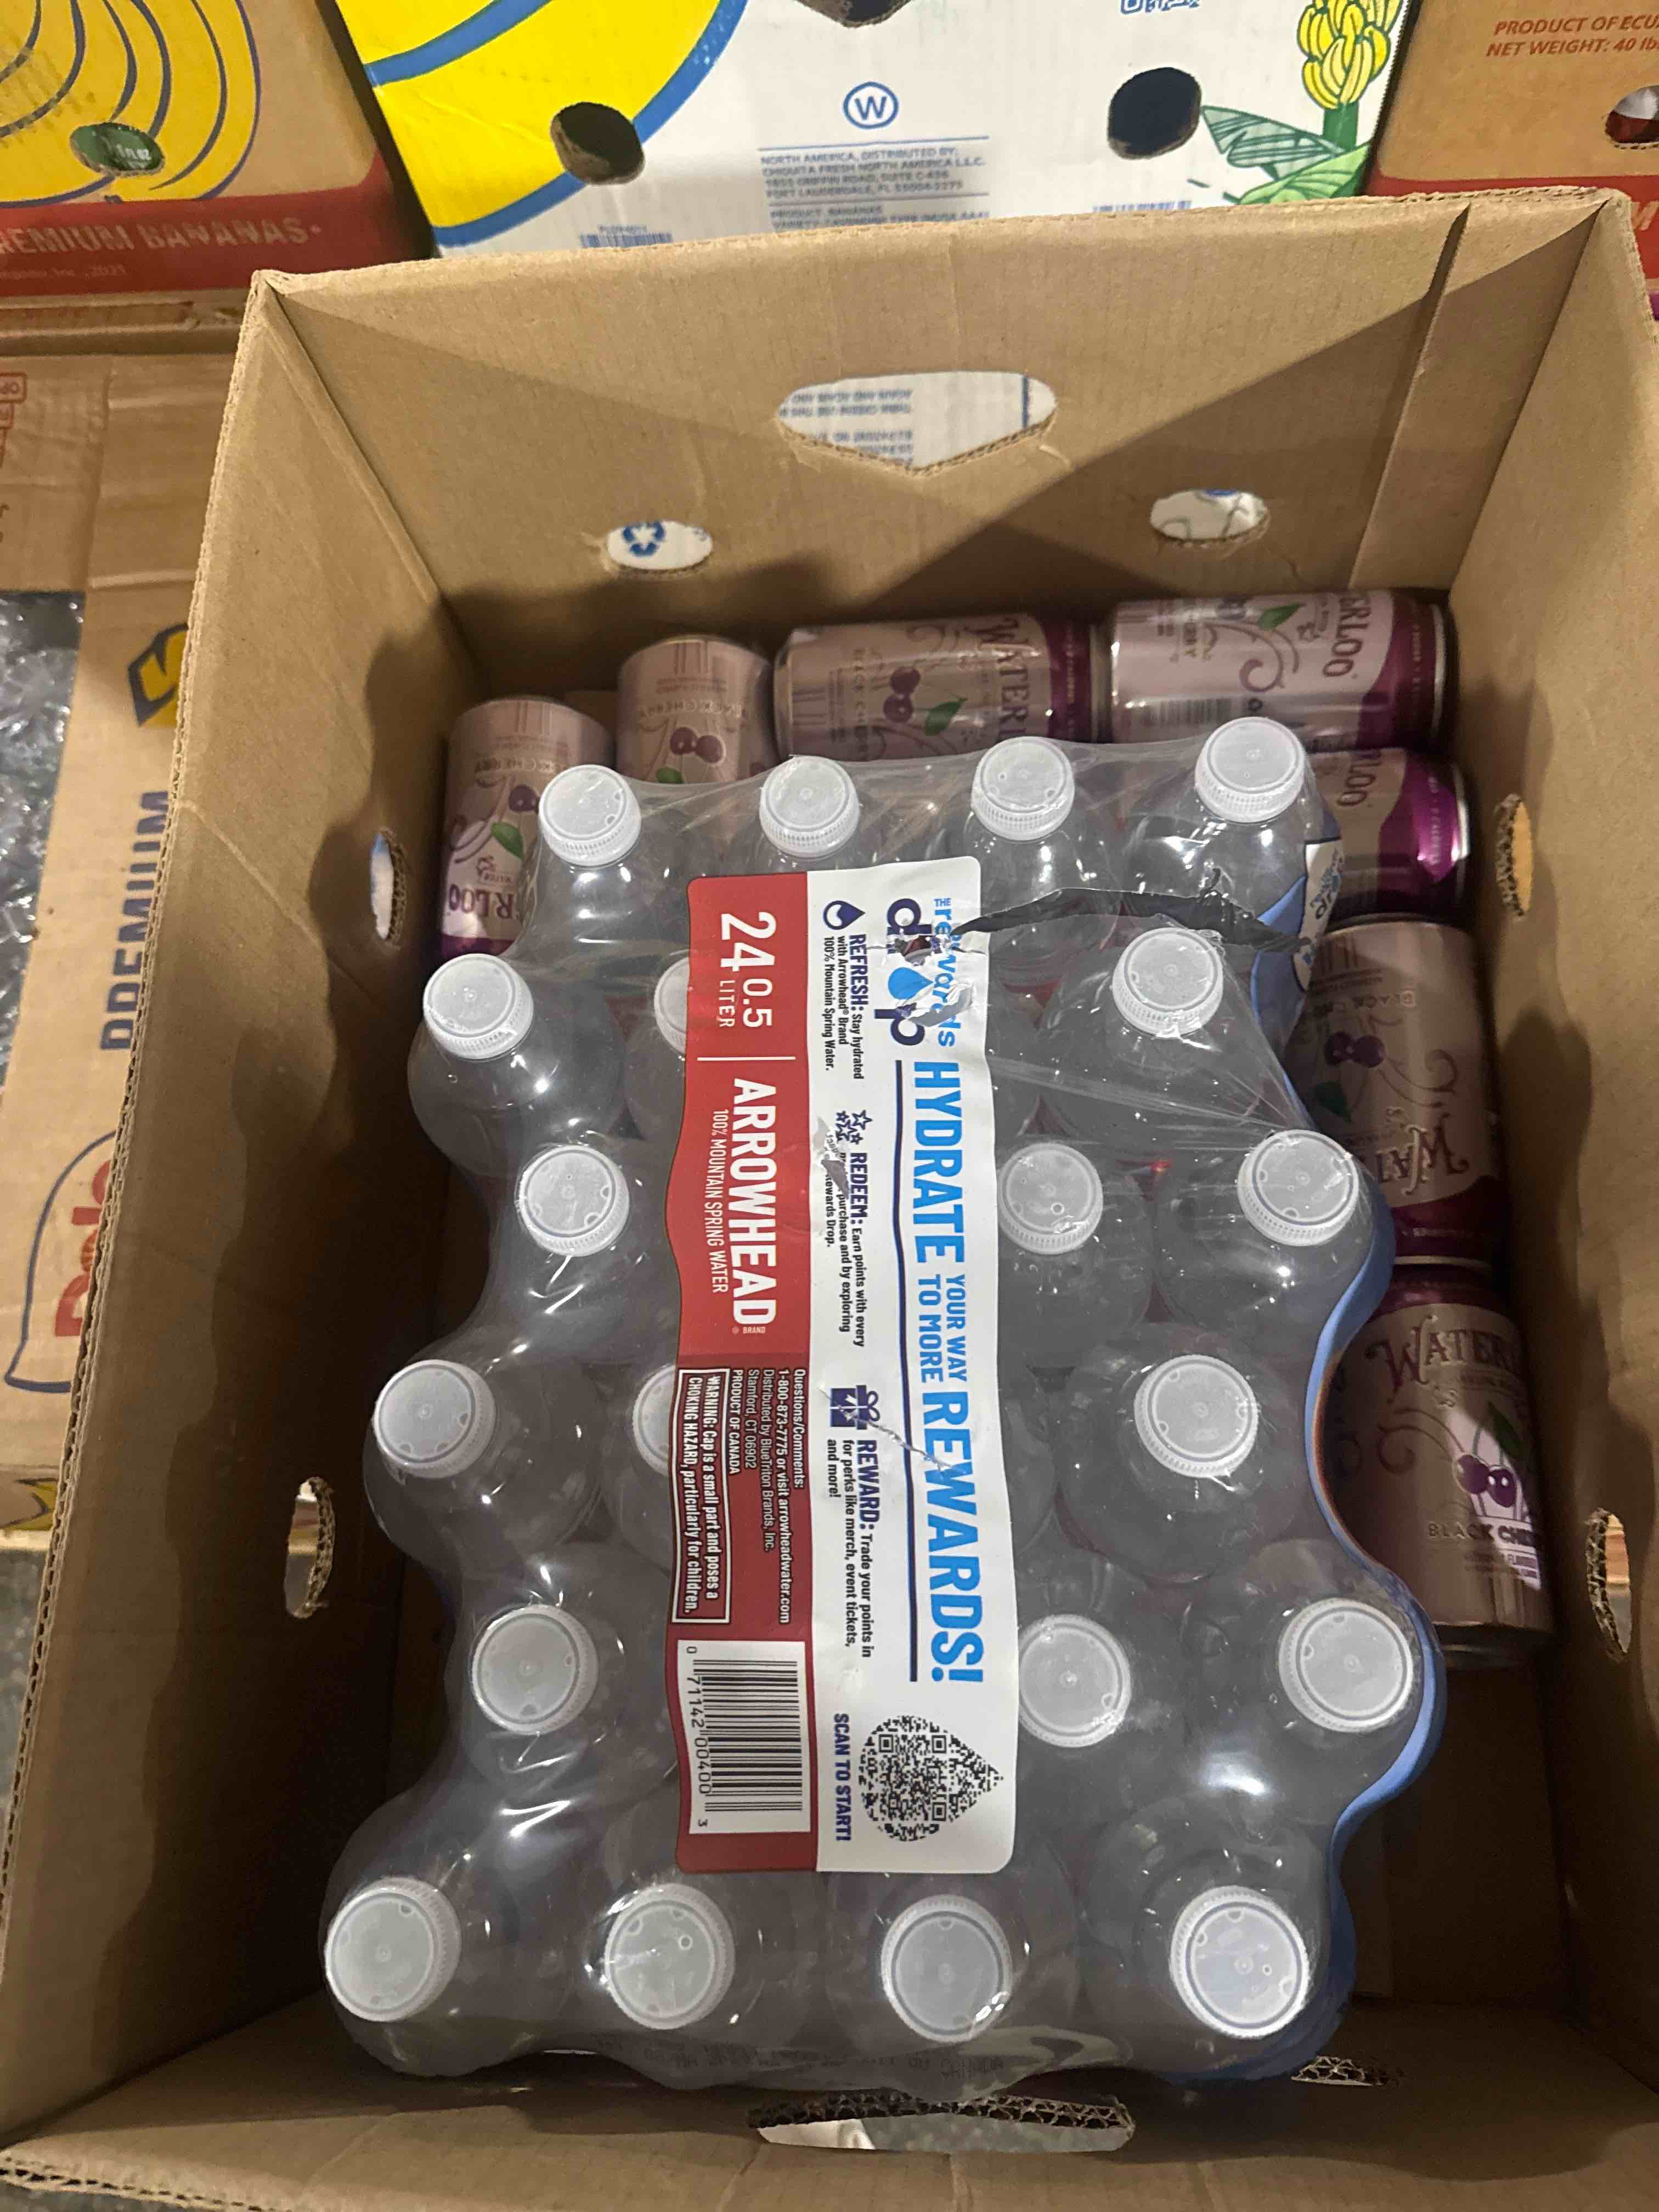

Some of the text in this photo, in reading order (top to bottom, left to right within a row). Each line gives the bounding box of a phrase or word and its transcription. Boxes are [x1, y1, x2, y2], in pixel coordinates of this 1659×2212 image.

[1486, 41, 1528, 57] NET
[1529, 38, 1611, 55] WEIGHT:
[1613, 38, 1637, 52] 40
[1493, 14, 1659, 36] PRODUCT OF ECU
[934, 898, 952, 907] THE
[720, 911, 777, 972] 24
[837, 936, 848, 955] with
[719, 980, 736, 1027] LITER
[743, 978, 773, 1027] 0.5
[822, 936, 835, 1071] 100% Mountain Spring Water.
[838, 1017, 849, 1045] Brand
[849, 934, 868, 1079] REFRESH: Stay hydrated
[913, 1061, 964, 1263] HYDRATE
[704, 1109, 729, 1294] 100% MOUNTAIN SPRING WATER
[729, 1078, 777, 1325] ARROWHEAD
[824, 1220, 837, 1248] Drop.
[837, 1194, 854, 1333] purchase and by exploring
[850, 1152, 868, 1347] REDEEM: Earn points with every
[918, 1274, 943, 1383] TO MORE
[946, 1274, 967, 1382] YOUR WAY
[703, 1376, 721, 1428] WARNING:
[729, 1369, 743, 1474] PRODUCT OF CANADA
[744, 1369, 759, 1468] Stamford, CT 06902
[793, 1369, 806, 1488] Questions/Comments:
[701, 1430, 716, 1449] Cap
[702, 1453, 716, 1463] is
[759, 1369, 776, 1551] Distributed by BlueTriton Brands, Inc.
[827, 1440, 842, 1498] and more!
[680, 1376, 703, 1613] CHOKING HAZARD, particularly for children.
[702, 1506, 720, 1529] part
[703, 1474, 719, 1503] small
[776, 1369, 792, 1623] 1-800-873-7775 or visit arrowheadwater.com
[706, 1532, 721, 1553] and
[840, 1439, 859, 1647] for perks like merch, event tickets,
[856, 1440, 880, 1657] REWARD: Trade your points in
[922, 1391, 985, 1683] REWARDS!
[704, 1556, 720, 1589] poses
[686, 1646, 697, 1654] 0
[693, 1737, 712, 1794] 00400
[834, 1713, 851, 1841] SCAN TO START!
[698, 1819, 708, 1827] 3
